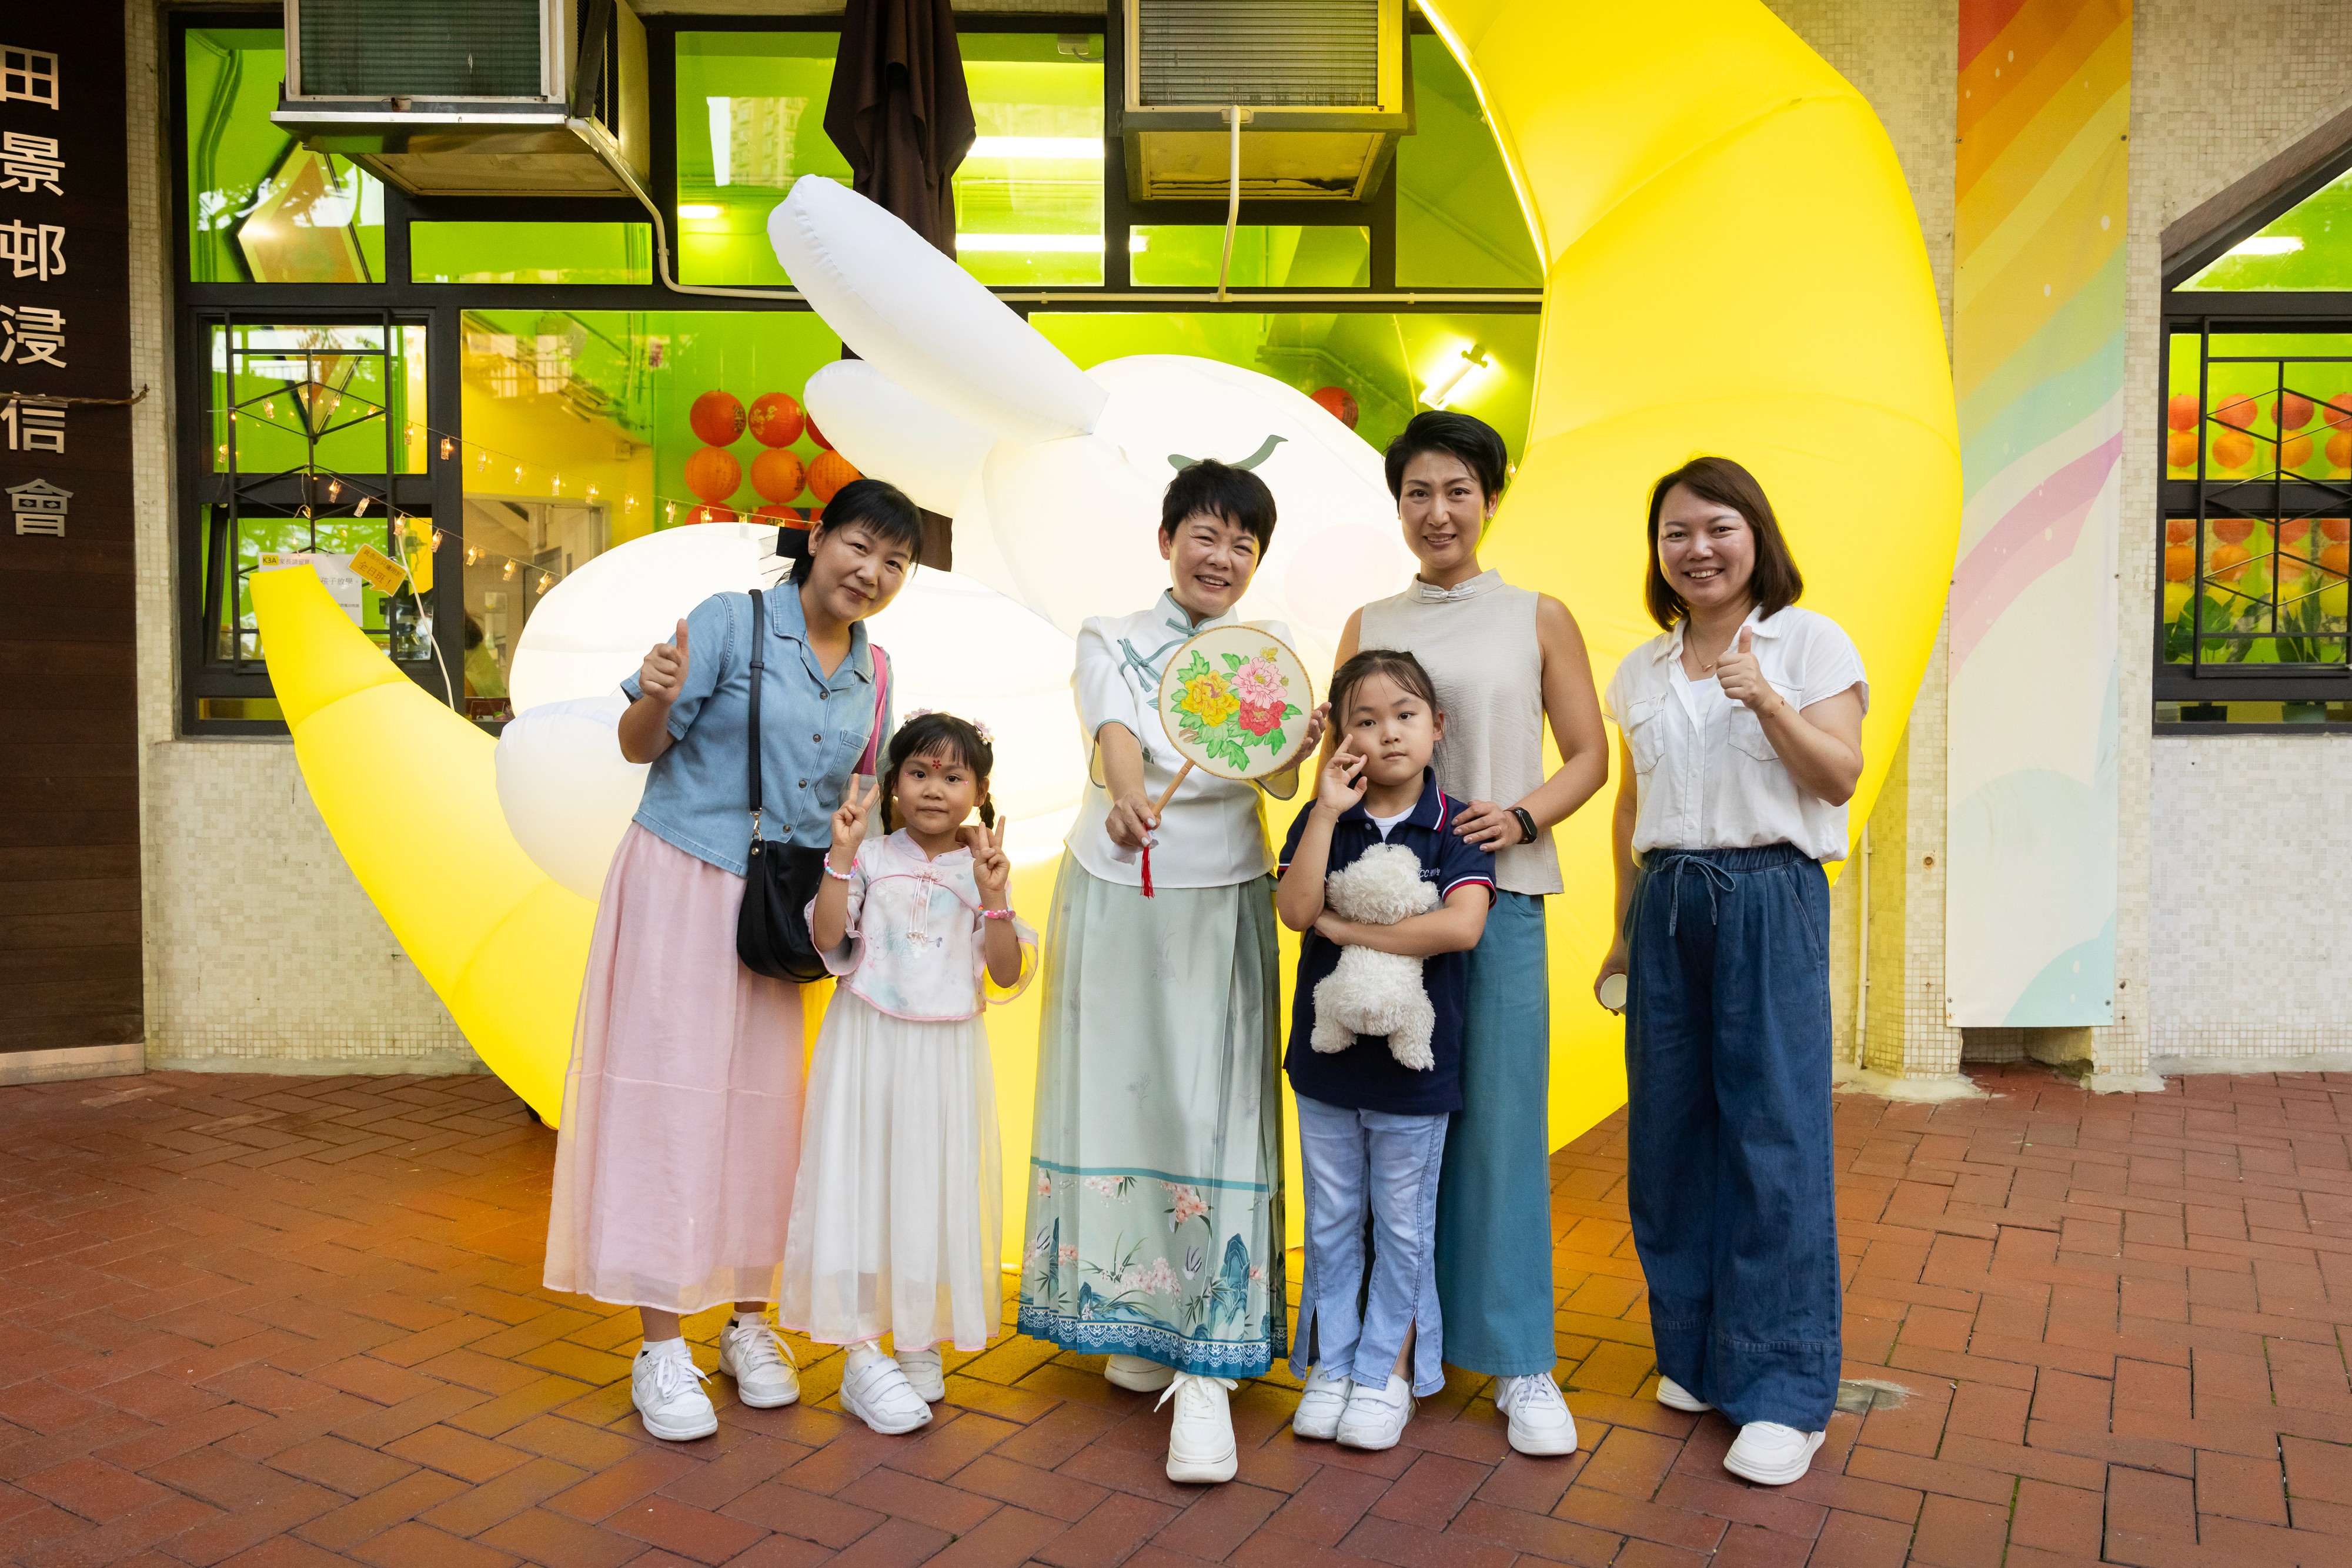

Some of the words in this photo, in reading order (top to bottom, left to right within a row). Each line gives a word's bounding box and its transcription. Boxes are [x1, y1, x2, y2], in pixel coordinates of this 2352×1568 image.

[0, 44, 74, 537] 田景邨浸信會
[319, 577, 358, 586] 孩子放學。
